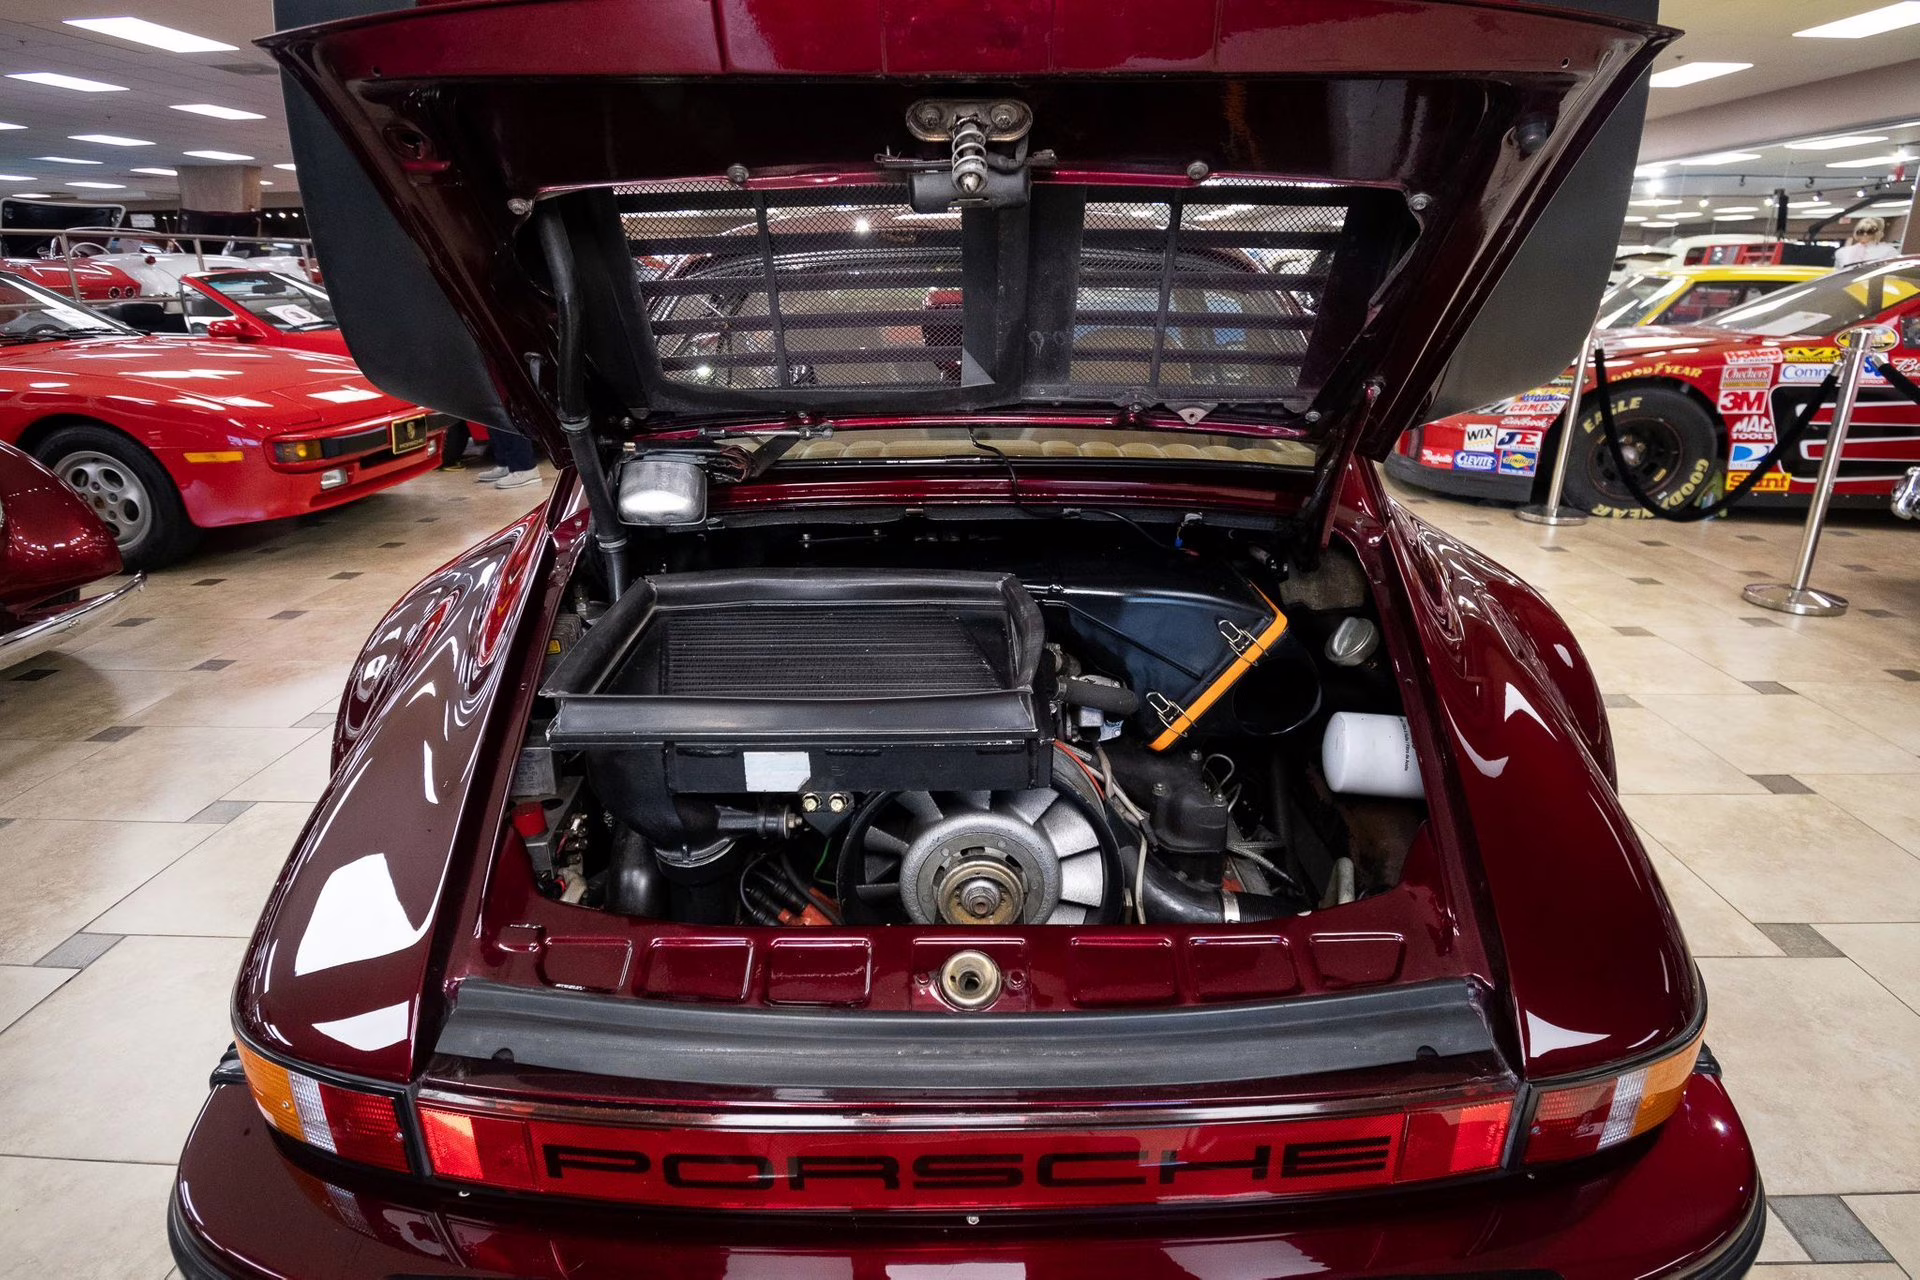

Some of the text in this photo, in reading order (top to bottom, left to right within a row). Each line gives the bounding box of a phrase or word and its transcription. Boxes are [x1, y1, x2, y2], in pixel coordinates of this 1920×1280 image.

[1721, 392, 1765, 411] 3M
[1732, 415, 1774, 432] MAC
[1467, 427, 1493, 441] WIX
[1498, 431, 1538, 446] JE
[1732, 432, 1773, 440] TOOLS
[1456, 452, 1494, 467] CLEVITE
[543, 1136, 1391, 1190] PORSCHE
